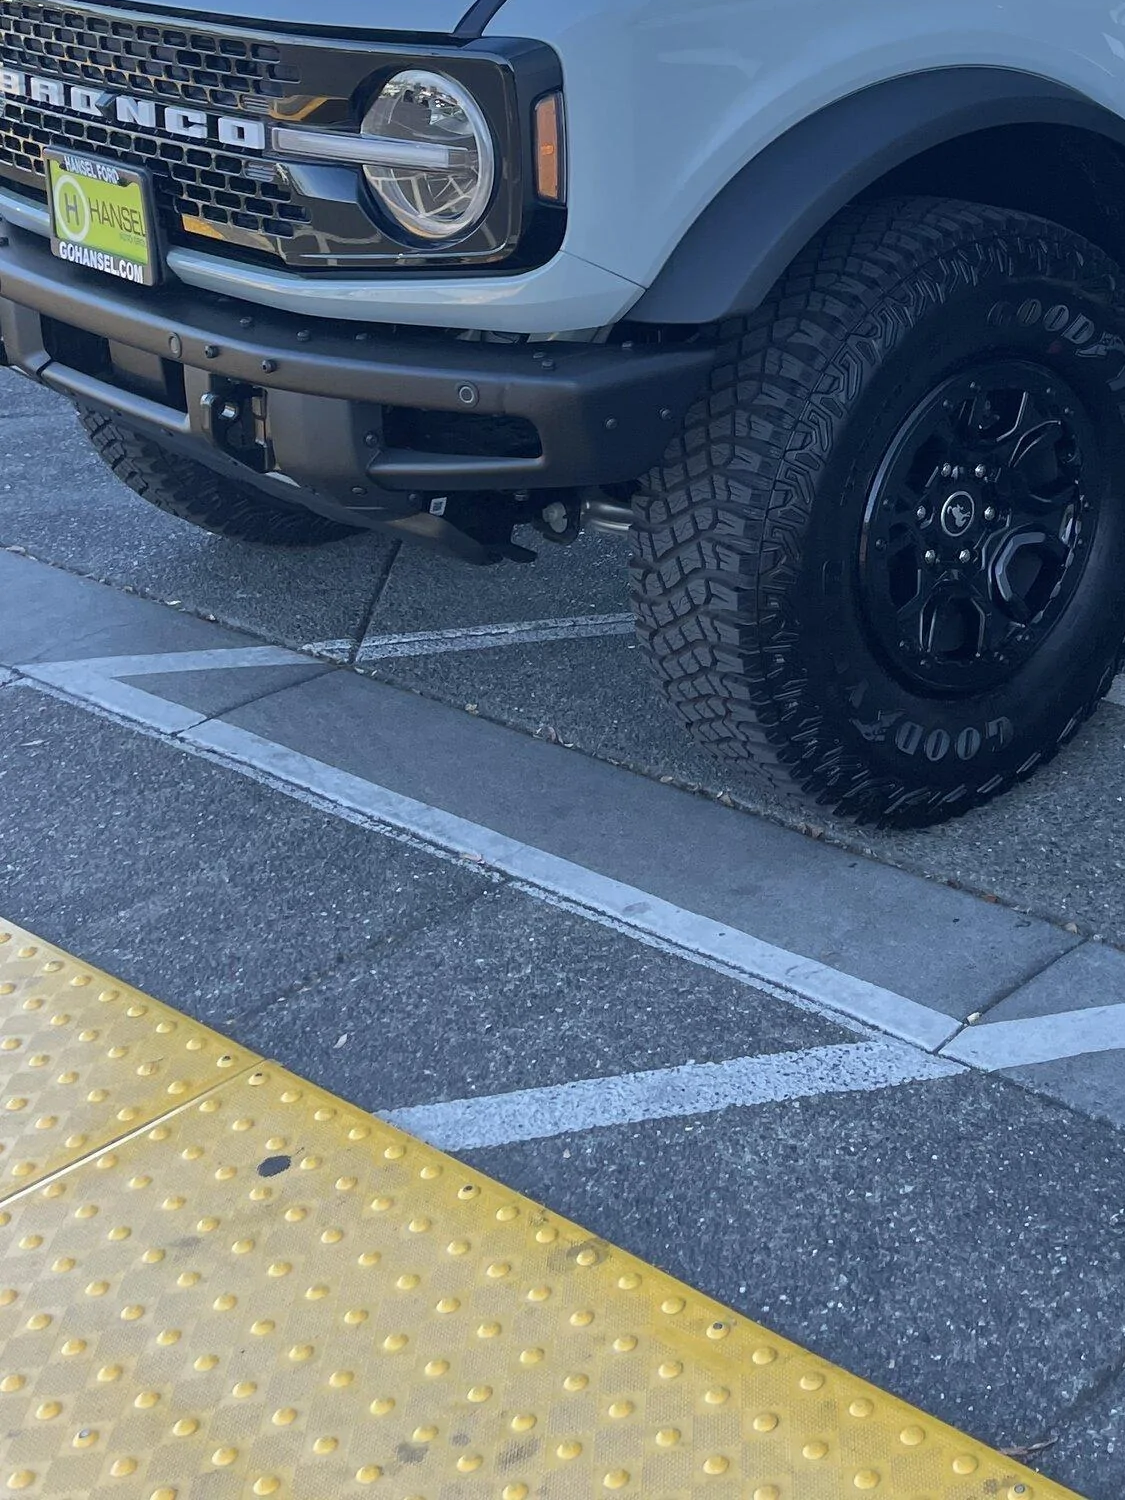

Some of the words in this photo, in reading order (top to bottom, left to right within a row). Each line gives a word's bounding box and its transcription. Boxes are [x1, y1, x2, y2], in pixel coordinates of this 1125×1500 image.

[64, 155, 97, 177] HANSEL
[96, 164, 120, 184] FORD
[88, 197, 147, 237] HANSEL
[60, 241, 145, 284] GOHANSEL.COM
